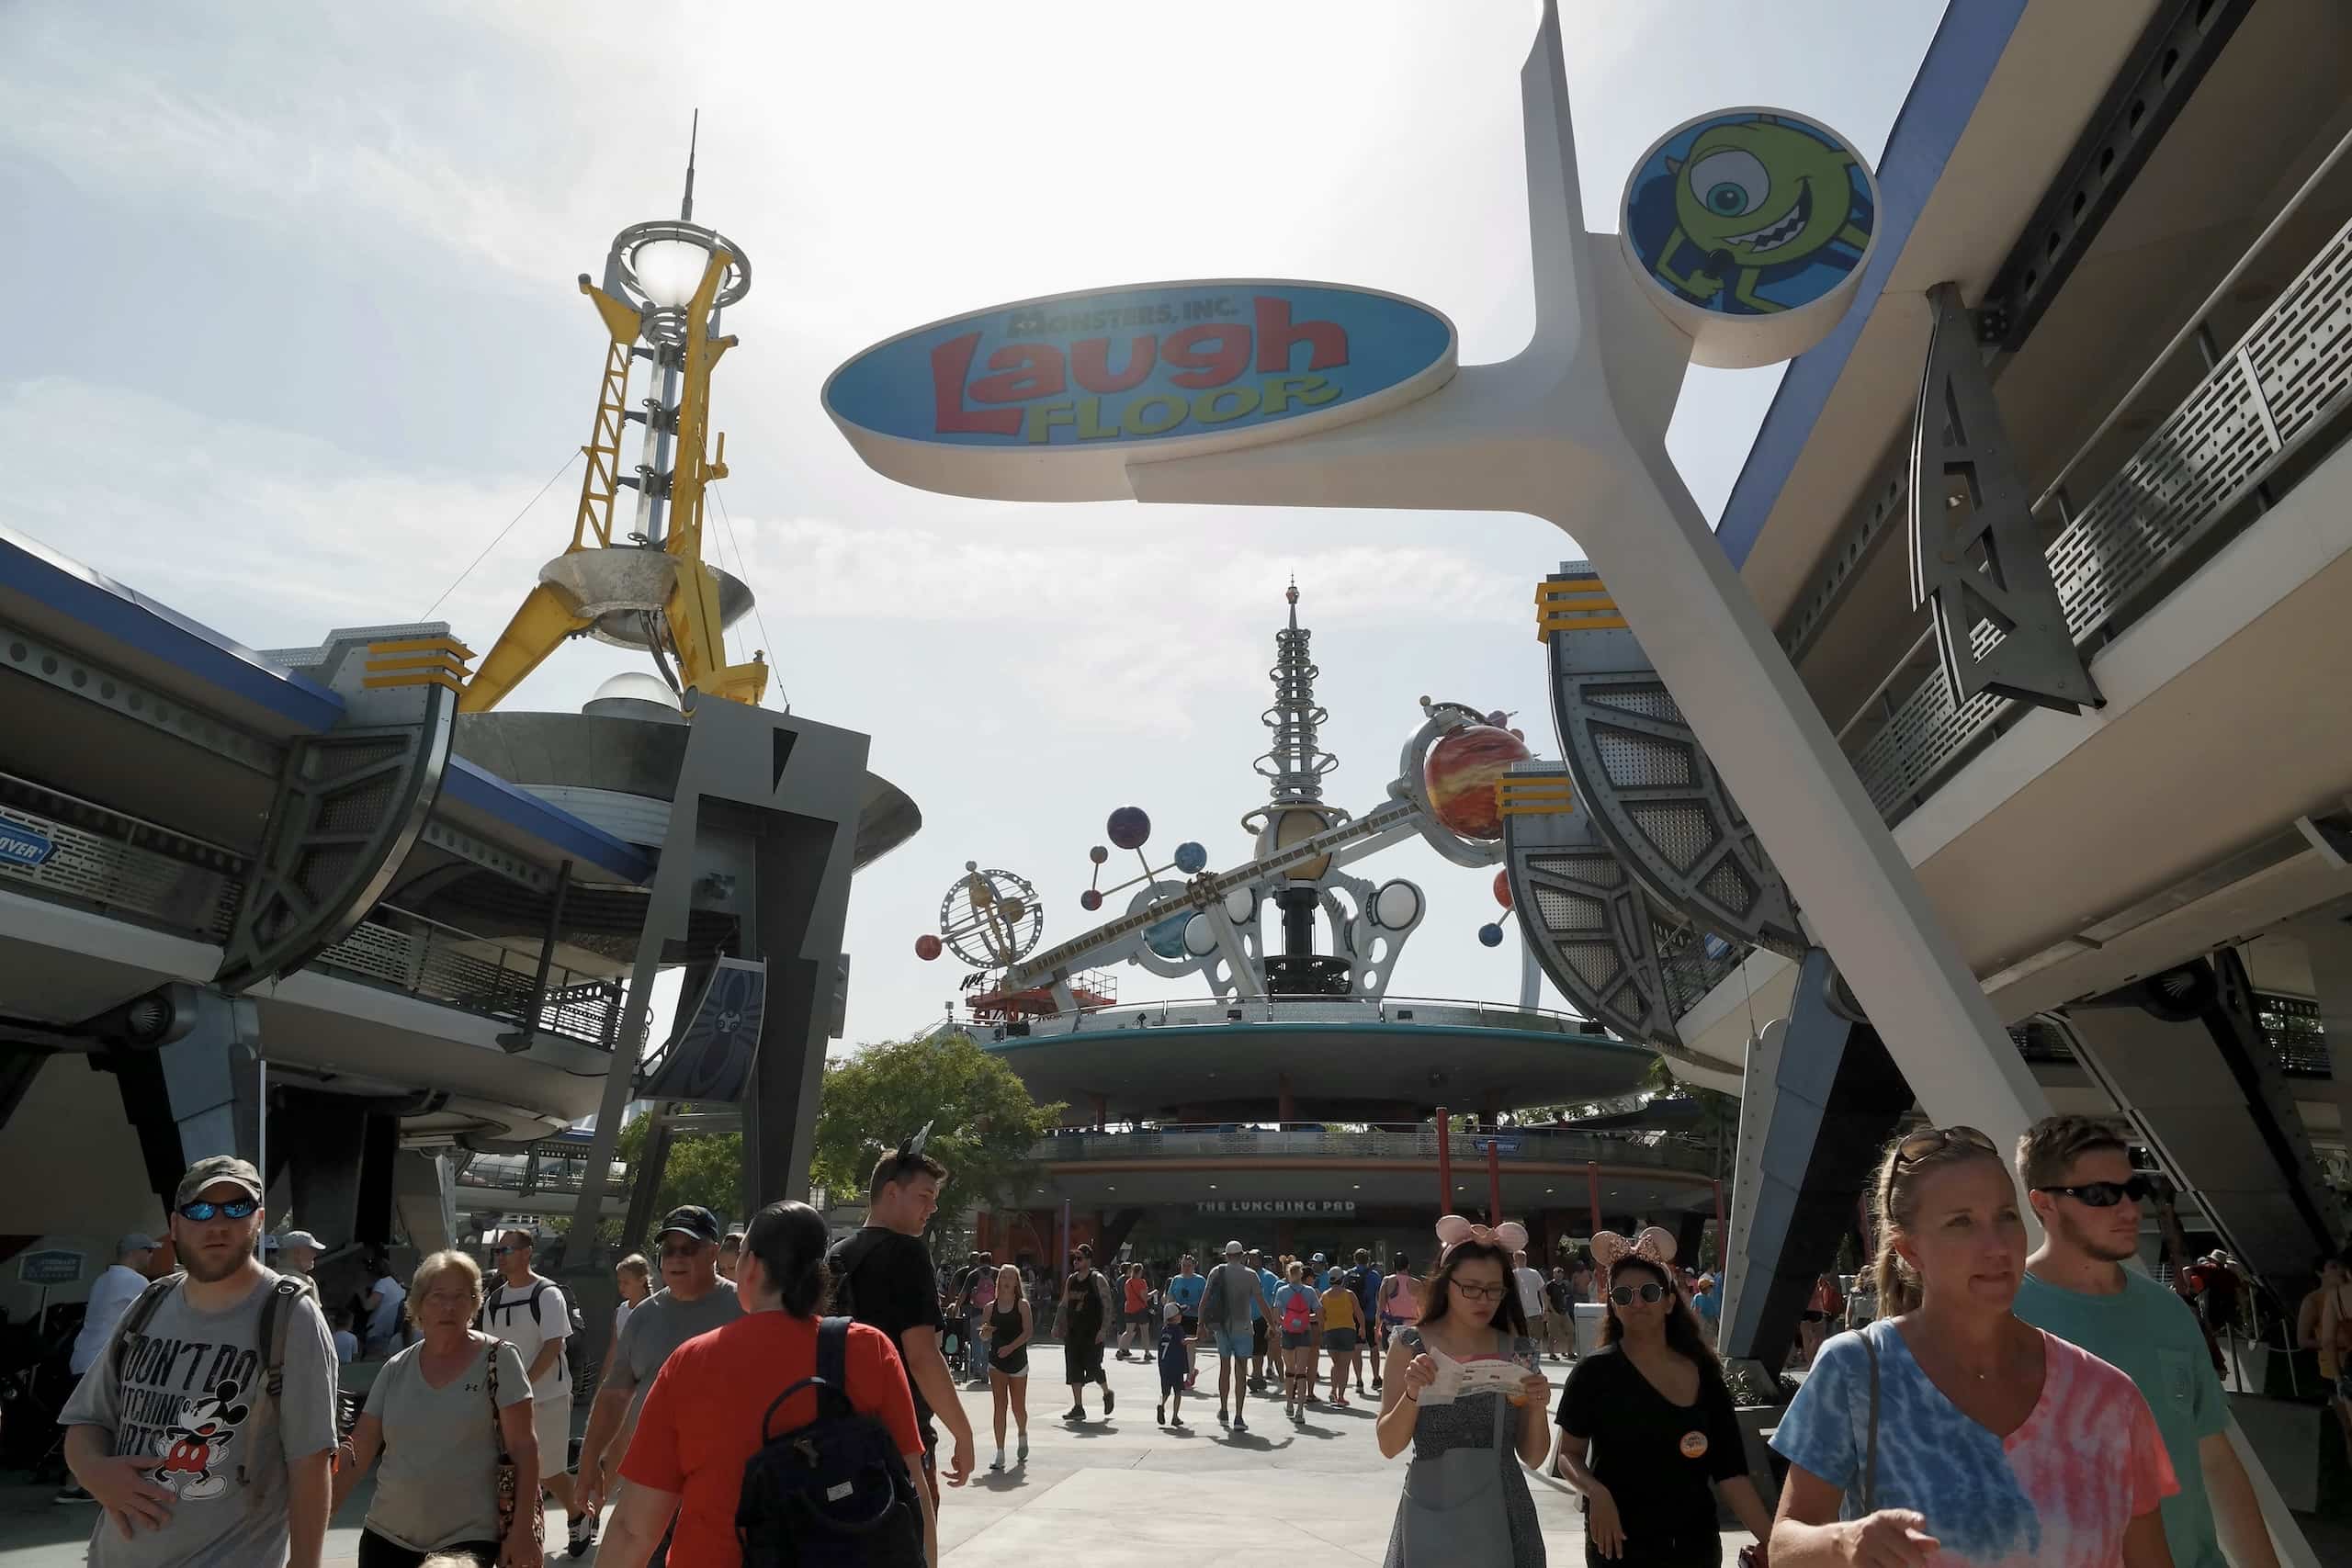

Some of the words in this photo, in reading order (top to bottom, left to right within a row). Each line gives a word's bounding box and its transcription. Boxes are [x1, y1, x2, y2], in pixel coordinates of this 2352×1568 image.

[1183, 296, 1238, 320] INC.
[931, 295, 1349, 435] Laugh
[1028, 376, 1342, 442] FLOOR
[1197, 1201, 1226, 1211] THE
[1232, 1201, 1317, 1212] LUNCHING
[1323, 1201, 1355, 1211] PAD
[202, 1345, 257, 1394] DO
[1161, 1342, 1170, 1360] 7
[119, 1387, 187, 1426] TCHING
